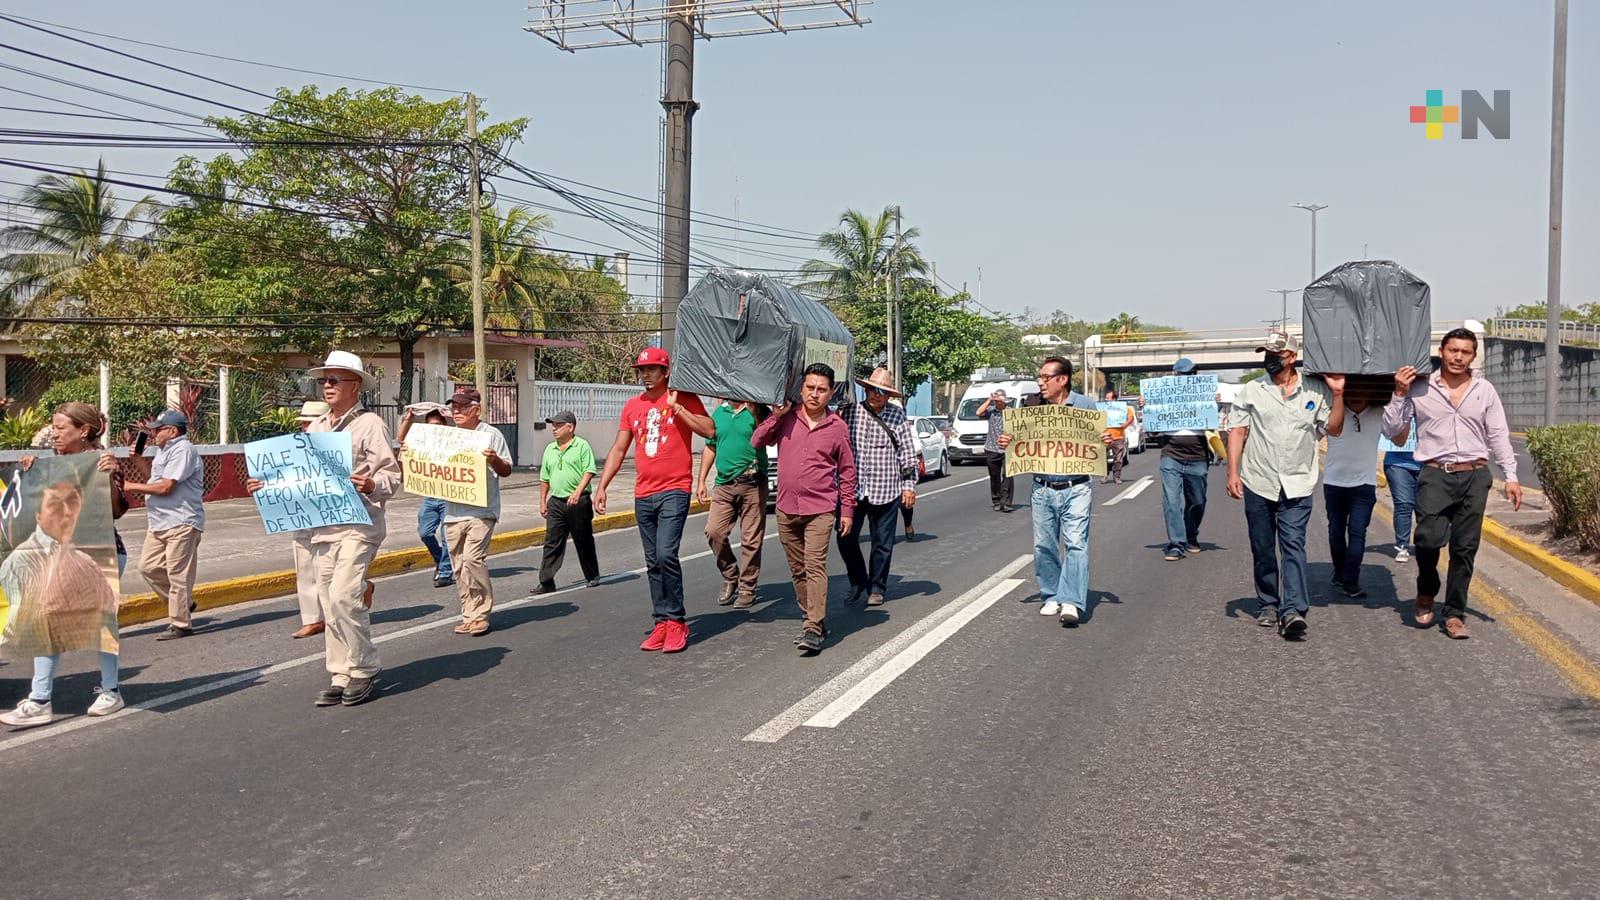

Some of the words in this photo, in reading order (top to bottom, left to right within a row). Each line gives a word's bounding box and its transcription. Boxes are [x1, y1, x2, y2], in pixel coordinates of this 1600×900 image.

[1173, 376, 1183, 386] LE
[1186, 375, 1214, 385] FINQUE
[1143, 384, 1217, 399] RESPONSABILIDAD
[1004, 410, 1017, 421] LA
[1020, 406, 1055, 418] FISCALIA
[1058, 406, 1072, 416] DEL
[1072, 409, 1101, 420] ESTADO
[1157, 409, 1197, 421] OMISION
[1012, 420, 1028, 432] HA
[1034, 415, 1095, 431] PERMITIDO
[1149, 421, 1161, 431] DE
[293, 432, 316, 450] SI
[1028, 430, 1044, 440] LOS
[1048, 428, 1101, 443] PRESUNTOS
[1014, 440, 1098, 460] CULPABLES
[247, 450, 294, 472] VALE
[1008, 459, 1046, 475] ANDEN
[1055, 460, 1095, 474] LIBRES
[262, 469, 285, 486] LA
[408, 458, 476, 484] CULPABLES
[256, 487, 293, 506] PERO
[296, 479, 332, 499] VALE
[406, 475, 436, 496] ANDEN
[440, 482, 477, 503] LIBRES
[283, 500, 306, 516] LA
[309, 493, 353, 511] VIDA
[266, 517, 289, 533] DE
[291, 514, 313, 529] UN
